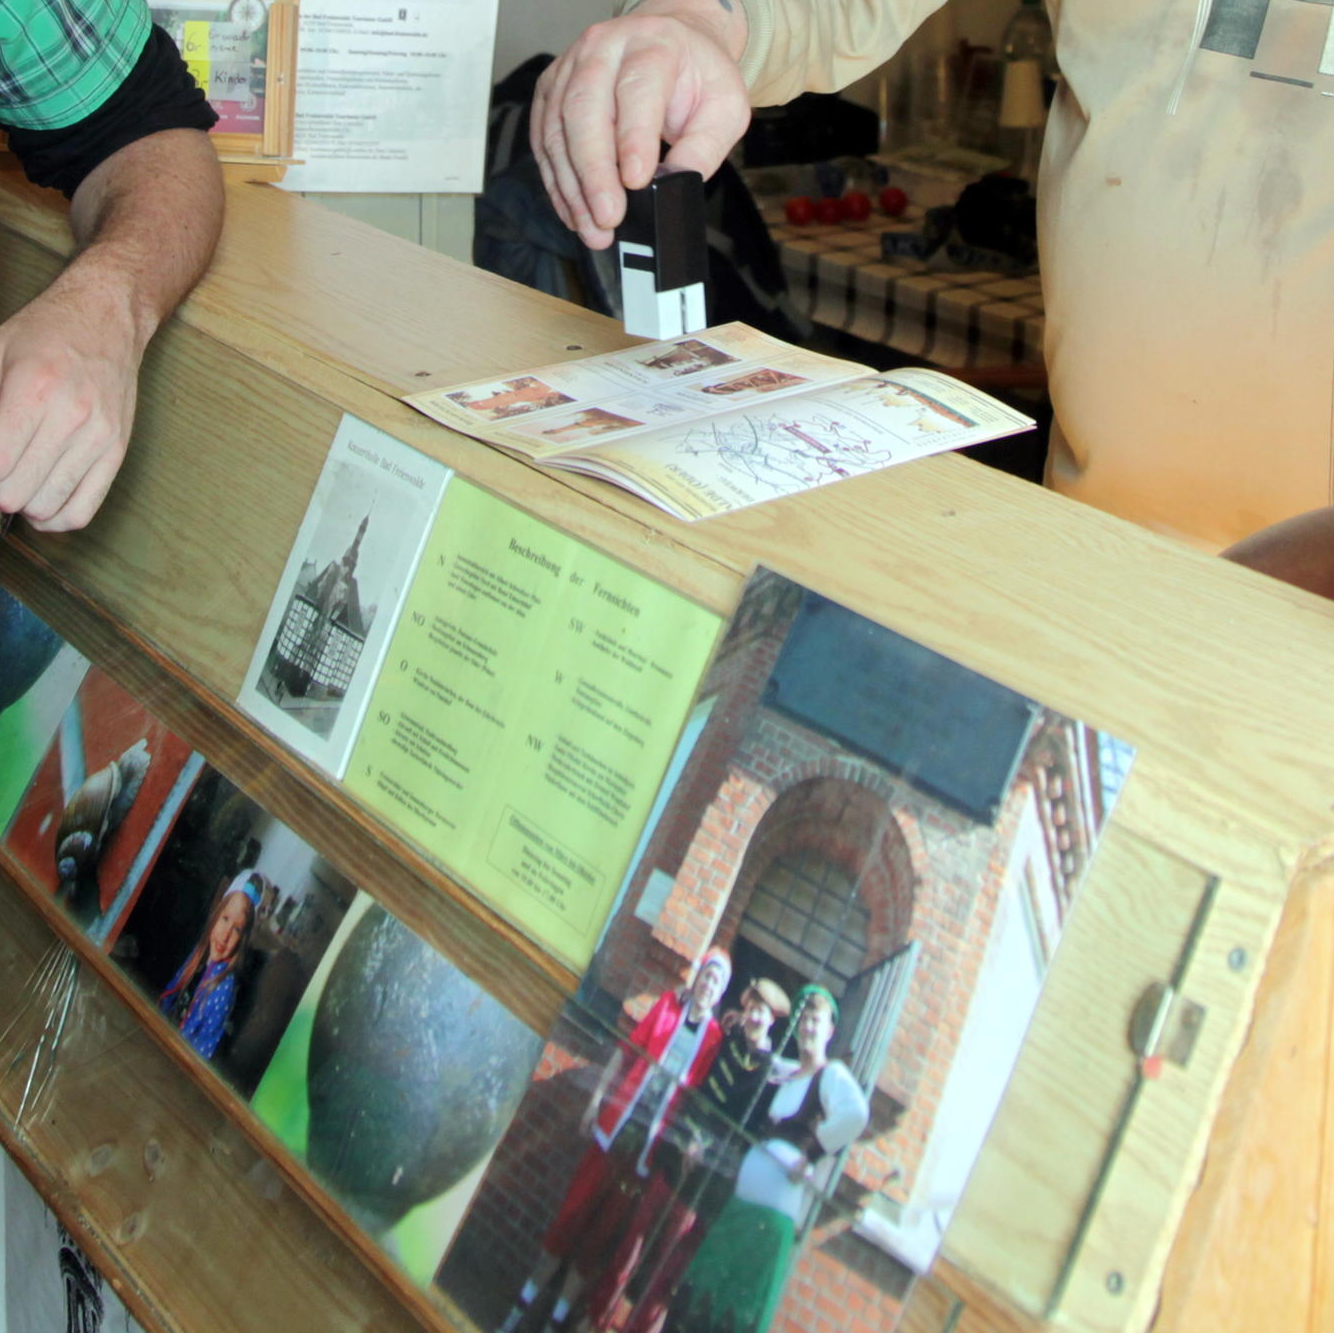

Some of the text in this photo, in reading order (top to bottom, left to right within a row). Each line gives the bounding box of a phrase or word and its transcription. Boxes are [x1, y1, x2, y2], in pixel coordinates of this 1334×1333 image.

[437, 554, 447, 567] N
[508, 538, 641, 618] Beschreibung der Fernsichten
[411, 611, 585, 635] NO SW
[526, 734, 543, 752] NW
